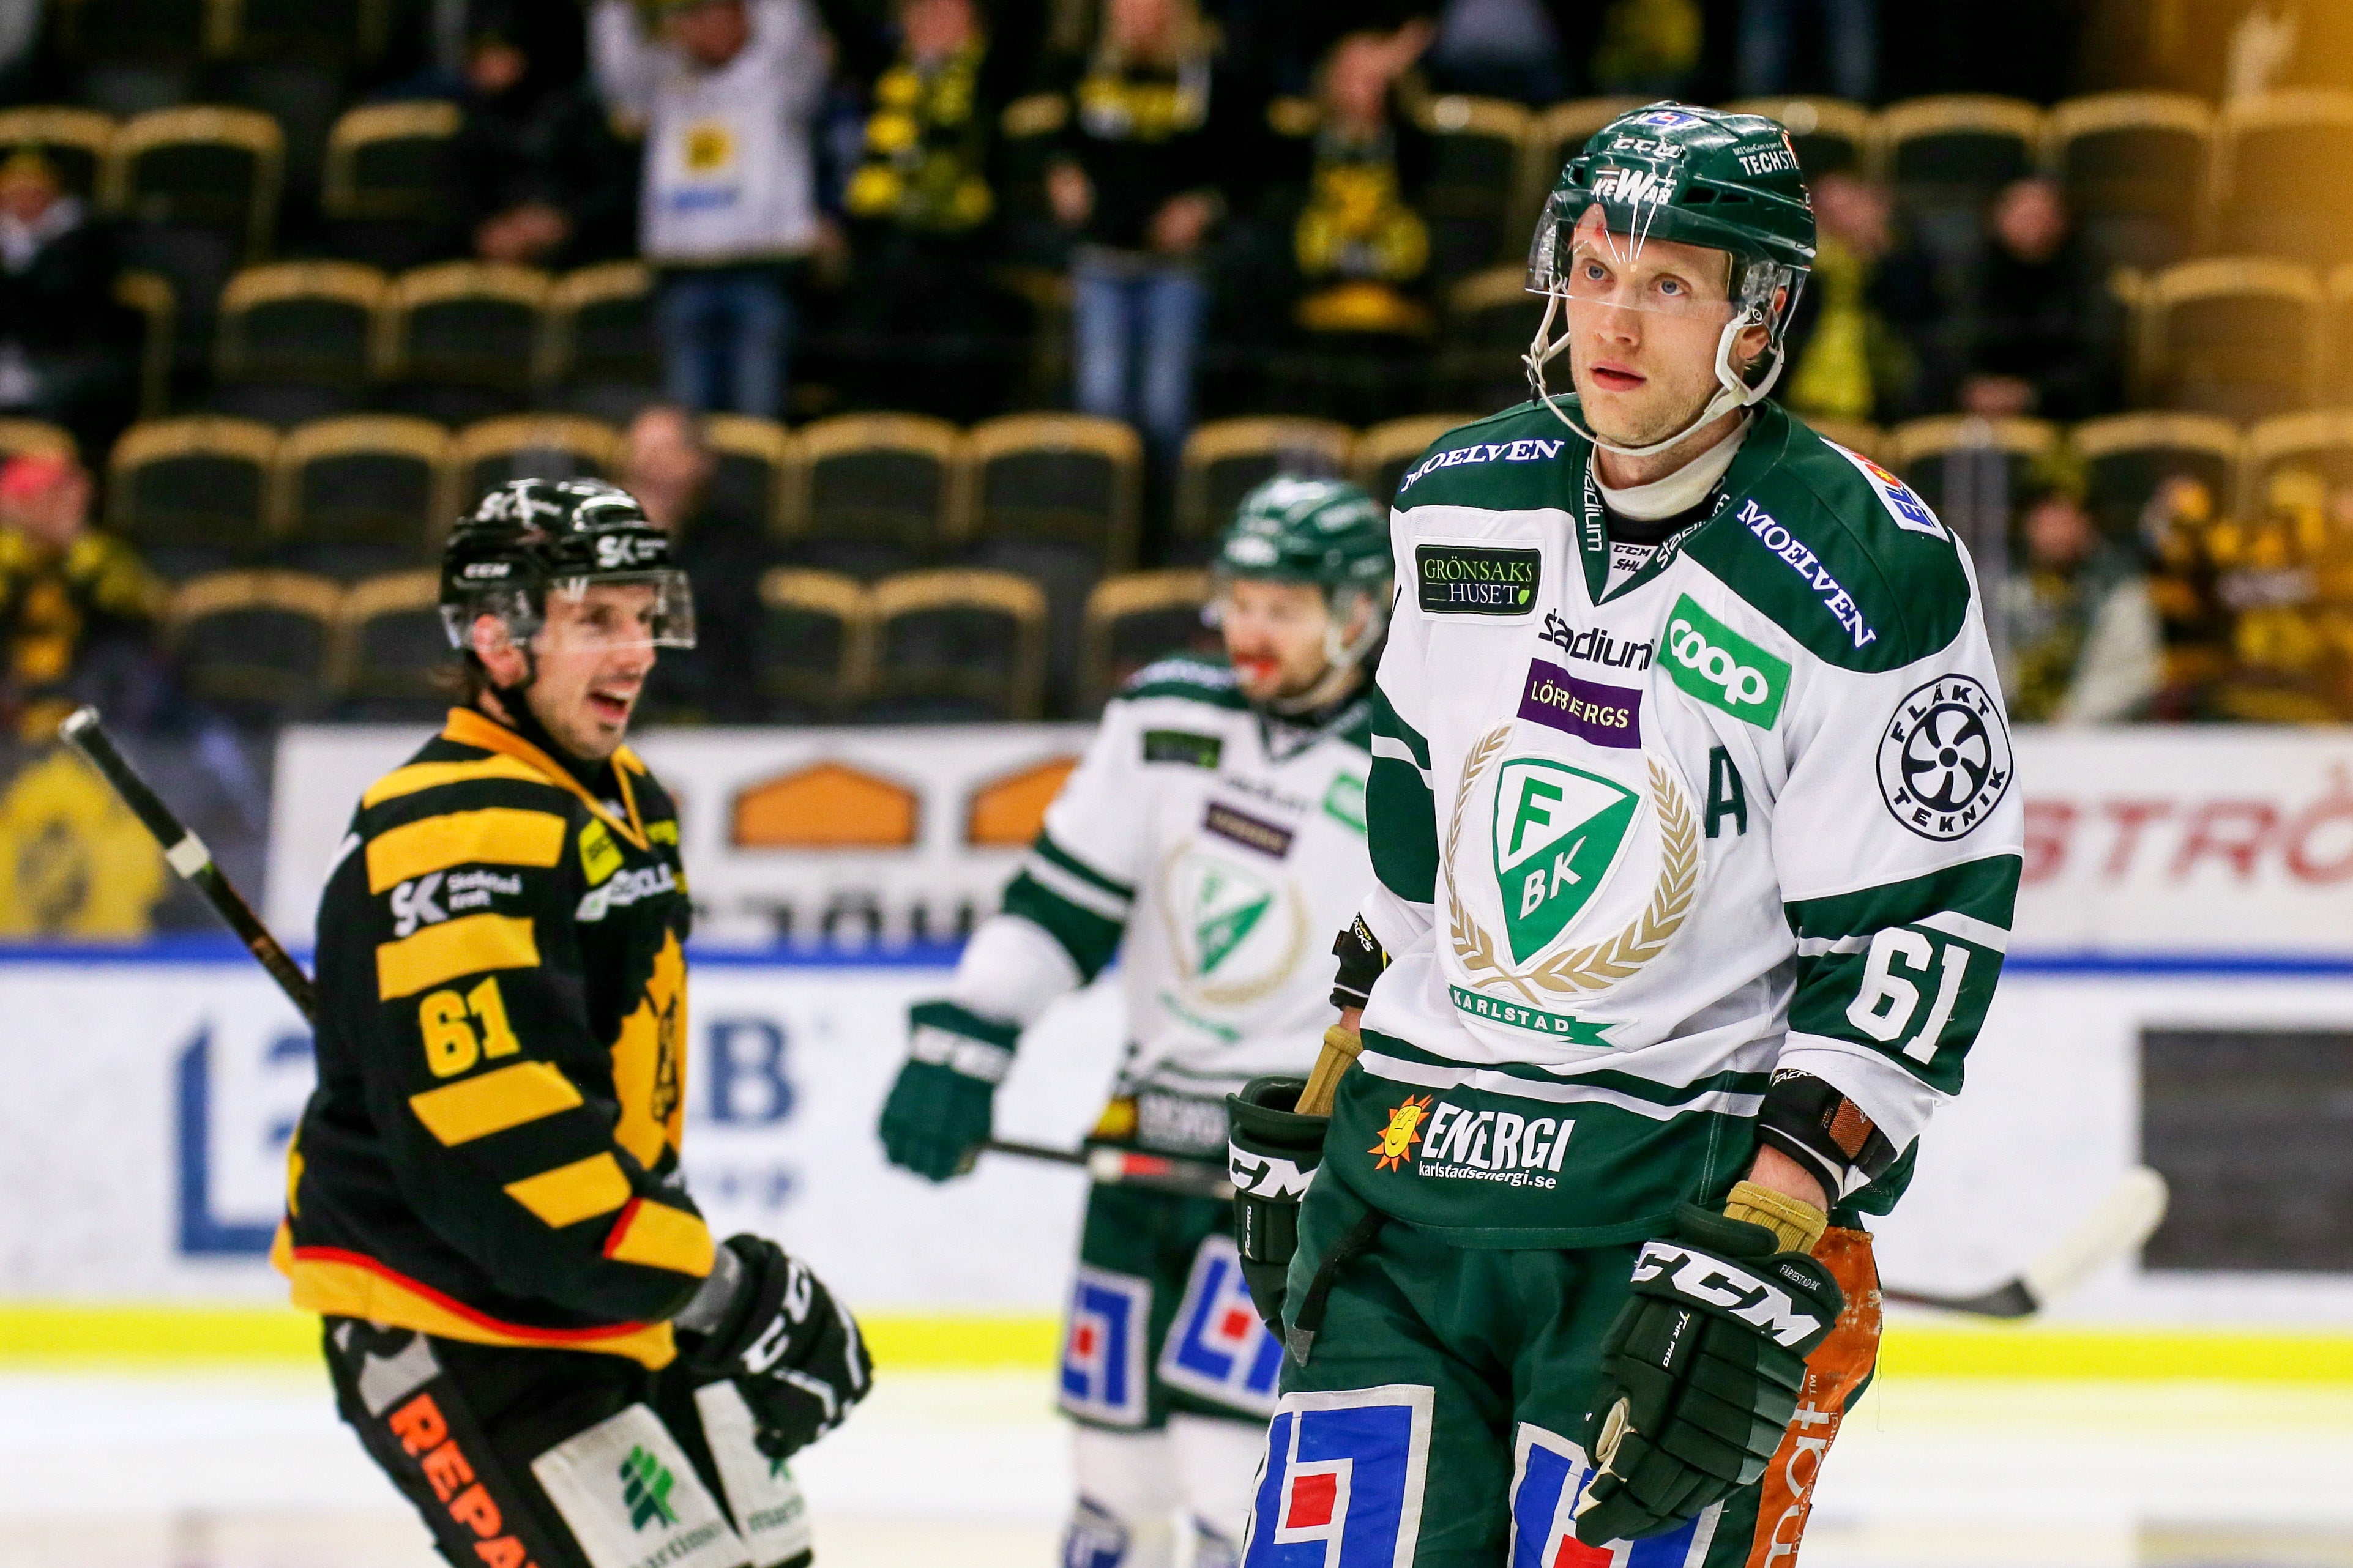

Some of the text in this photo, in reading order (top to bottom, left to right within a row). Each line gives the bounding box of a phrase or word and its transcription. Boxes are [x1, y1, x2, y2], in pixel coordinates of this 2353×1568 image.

[1613, 137, 1680, 160] CCM
[1401, 439, 1565, 492] MOELVEN
[1424, 555, 1532, 582] GRÖNSAKS
[1613, 544, 1652, 557] CCM
[1613, 558, 1641, 573] SHL
[1736, 499, 1877, 649] MOELVEN
[1449, 583, 1519, 604] HUSET
[1669, 619, 1769, 705] coop
[1890, 683, 1989, 743] FLÄKT
[1508, 776, 1563, 857] F
[1706, 745, 1747, 838] A
[1893, 767, 2005, 832] TEKNIK
[1519, 836, 1587, 920] BK
[419, 976, 521, 1077] 61
[1453, 990, 1569, 1033] KARLSTAD
[1845, 926, 1970, 1064] 61
[1420, 1101, 1576, 1172] ENERGI
[1419, 1160, 1557, 1189] karlstadsenergi.se
[1630, 1241, 1821, 1347] CCM
[1663, 1340, 1676, 1368] PRO
[389, 1392, 539, 1568] REPA
